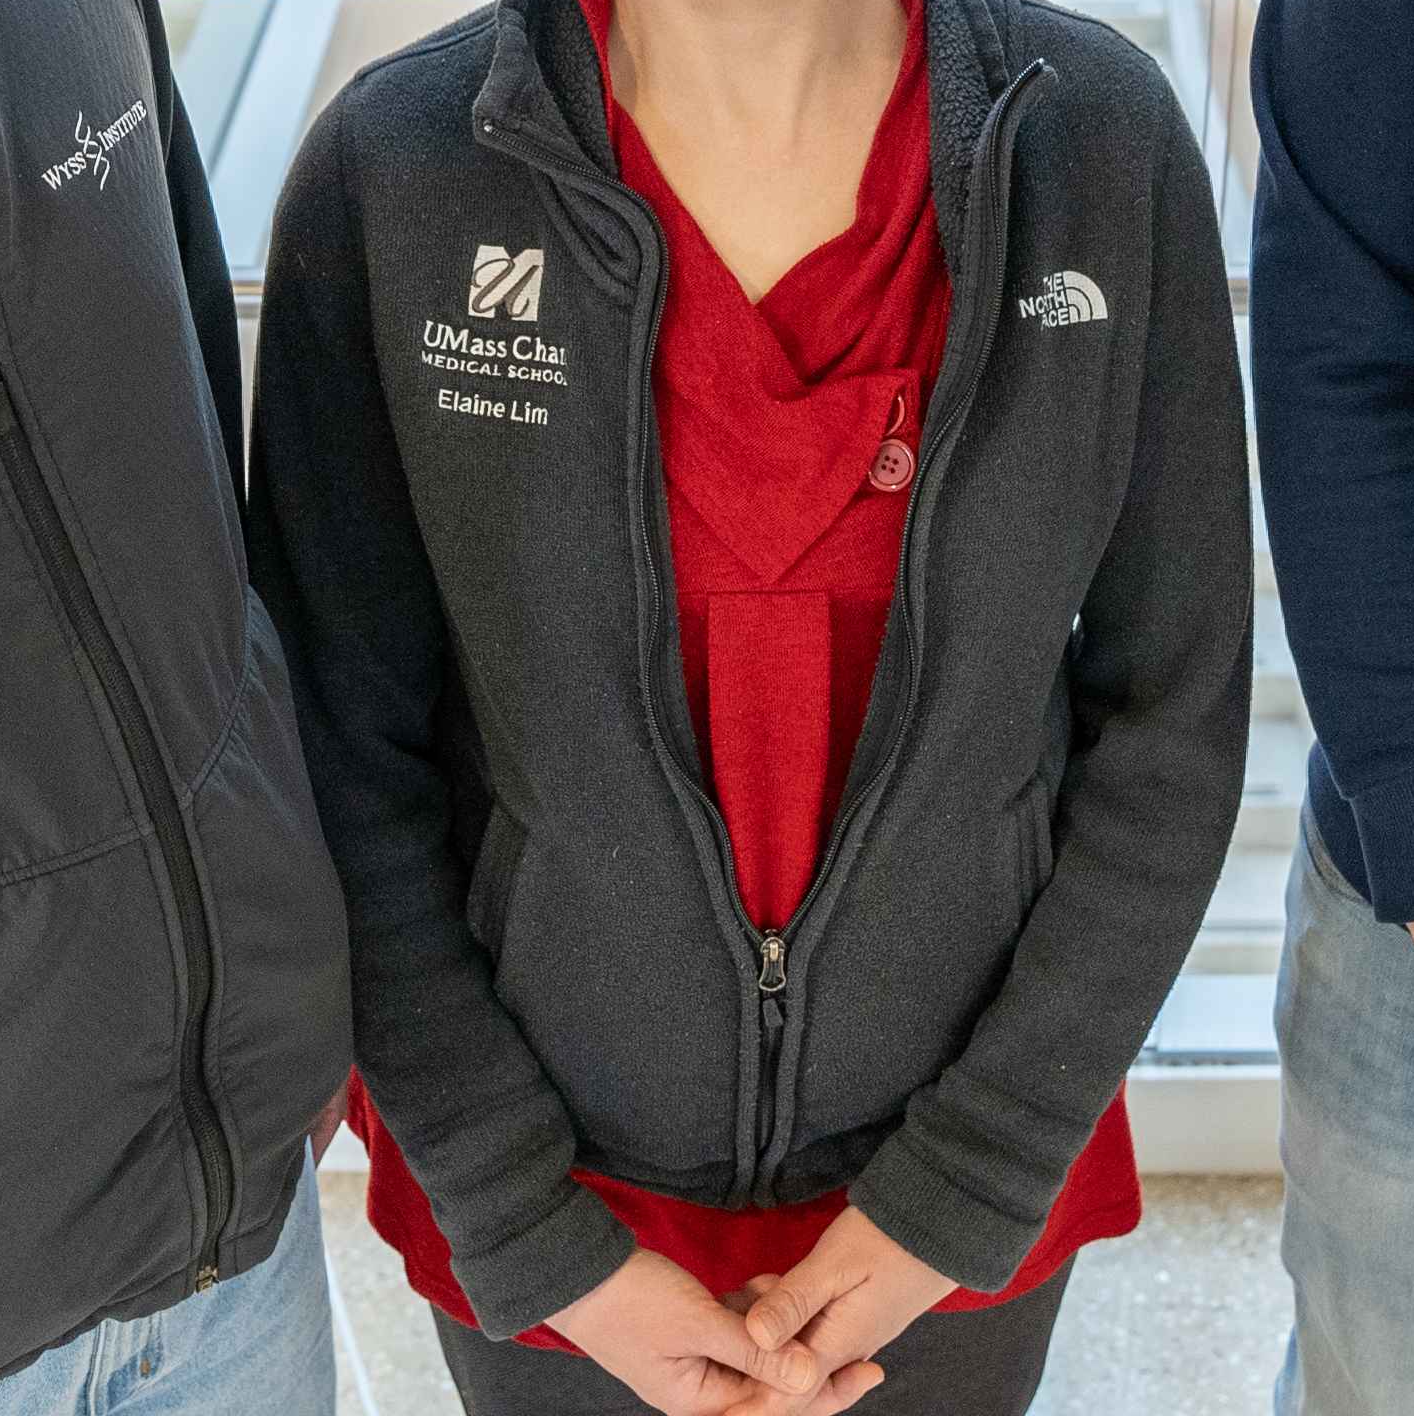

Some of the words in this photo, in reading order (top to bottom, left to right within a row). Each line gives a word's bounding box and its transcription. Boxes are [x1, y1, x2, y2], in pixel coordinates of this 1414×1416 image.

[1040, 307, 1070, 331] ACE
[423, 320, 507, 358] UMass
[421, 350, 501, 376] MEDICAL
[507, 364, 568, 386] SCHOO
[438, 388, 506, 418] Elaine
[510, 400, 548, 426] Lim
